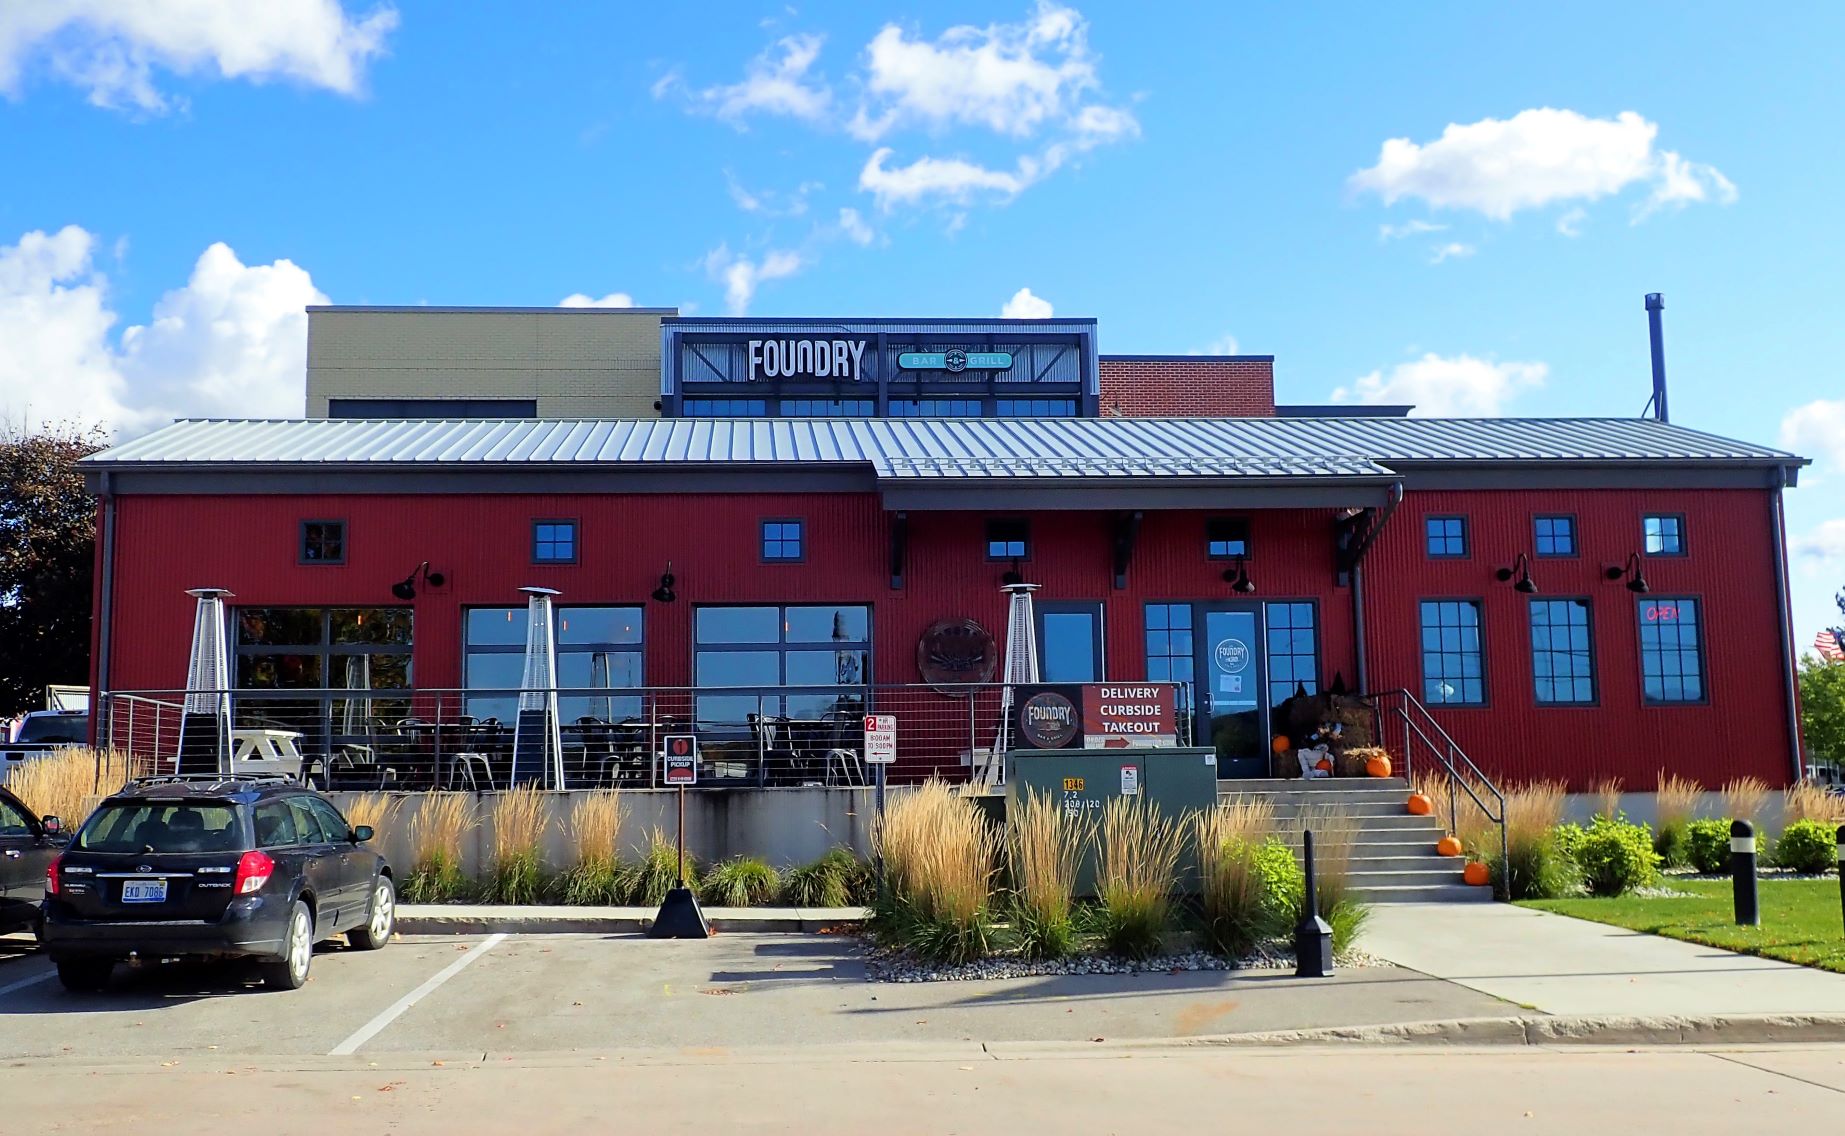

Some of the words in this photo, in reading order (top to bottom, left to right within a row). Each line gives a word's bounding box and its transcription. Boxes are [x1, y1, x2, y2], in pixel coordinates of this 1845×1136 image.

[748, 340, 866, 381] FOUNDRY
[912, 357, 937, 365] BAR
[970, 357, 1004, 365] GRILL
[1646, 606, 1681, 621] OPEN
[1219, 647, 1245, 659] FOUNDRY
[1101, 687, 1160, 699] DELIVERY
[1028, 706, 1071, 726] FOUNDRY
[1100, 705, 1161, 716] CURBSIDE
[868, 718, 875, 730] 2
[1102, 722, 1161, 733] TAKEOUT
[1064, 779, 1083, 790] 1346
[144, 886, 164, 898] 7086
